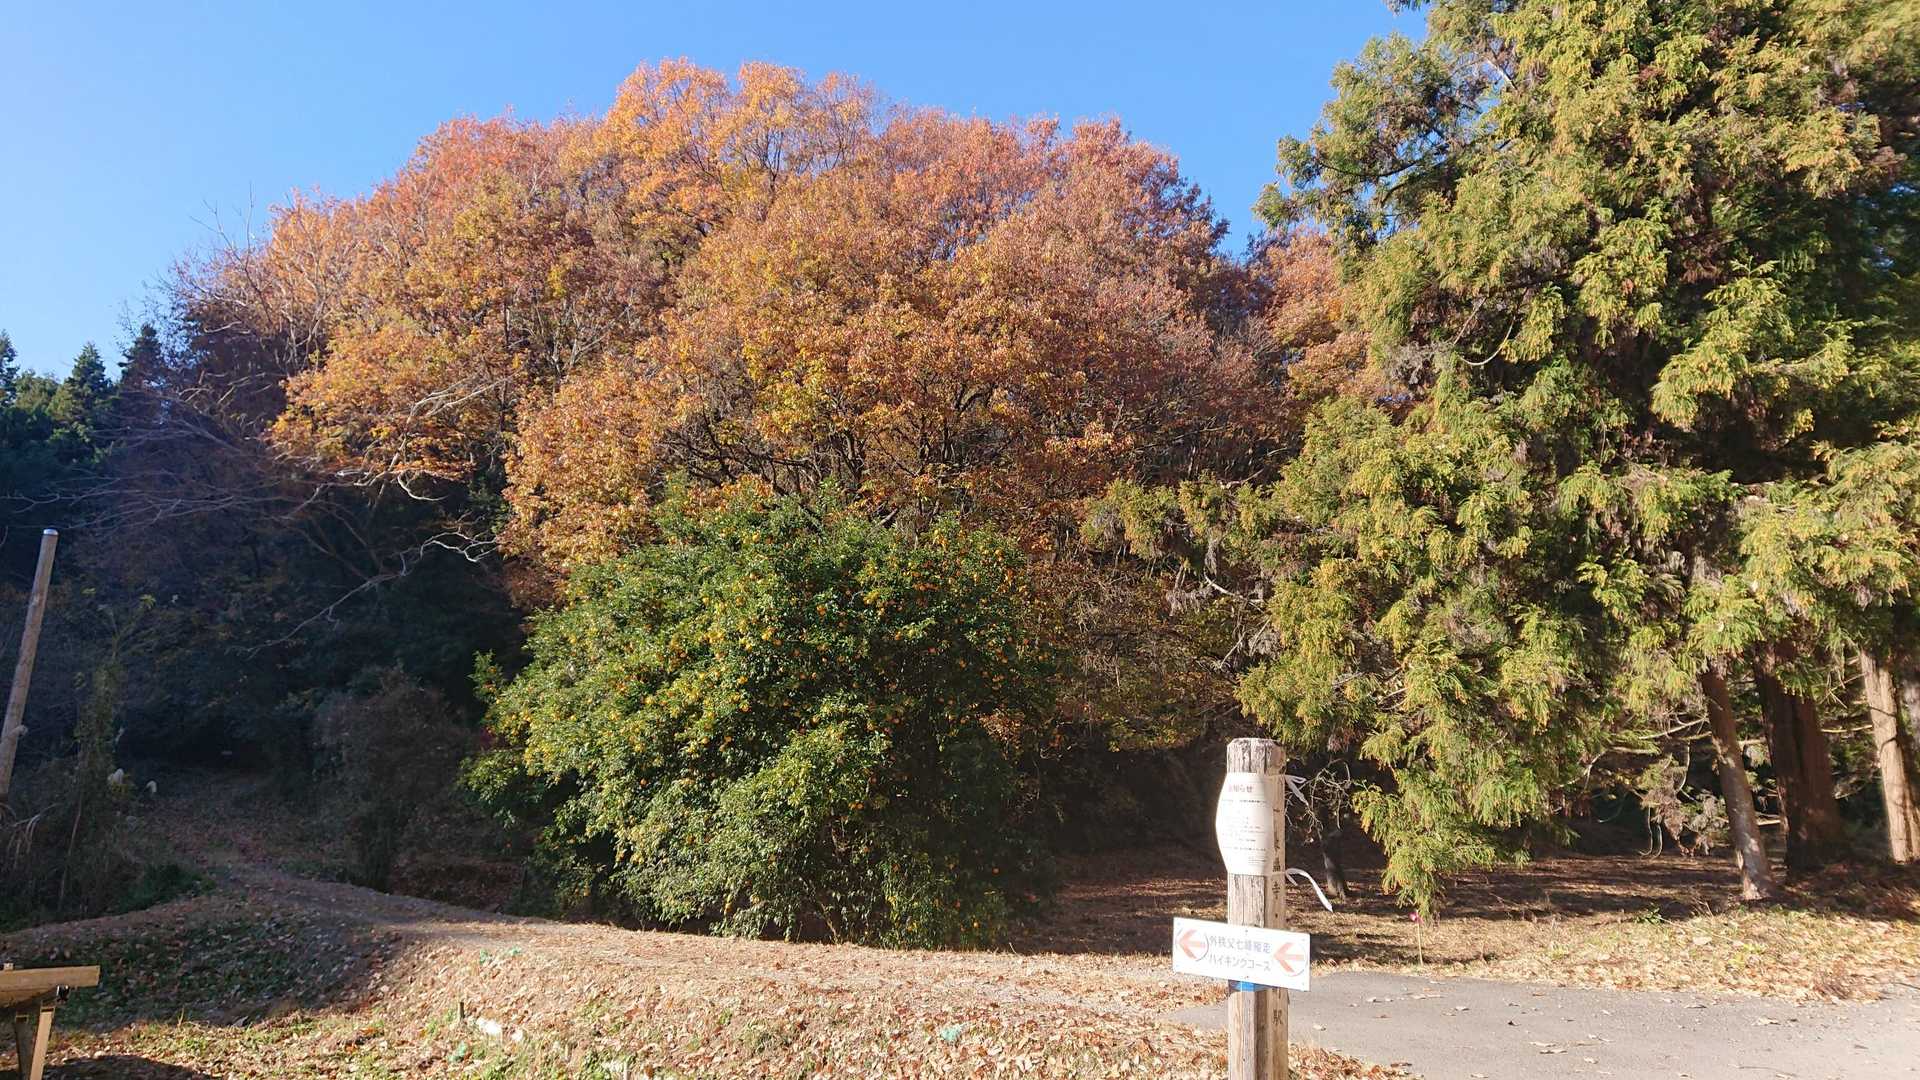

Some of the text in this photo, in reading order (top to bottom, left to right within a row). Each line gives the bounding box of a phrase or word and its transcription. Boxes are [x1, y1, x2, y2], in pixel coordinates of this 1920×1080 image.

[1208, 953, 1271, 972] ハイキングコース
